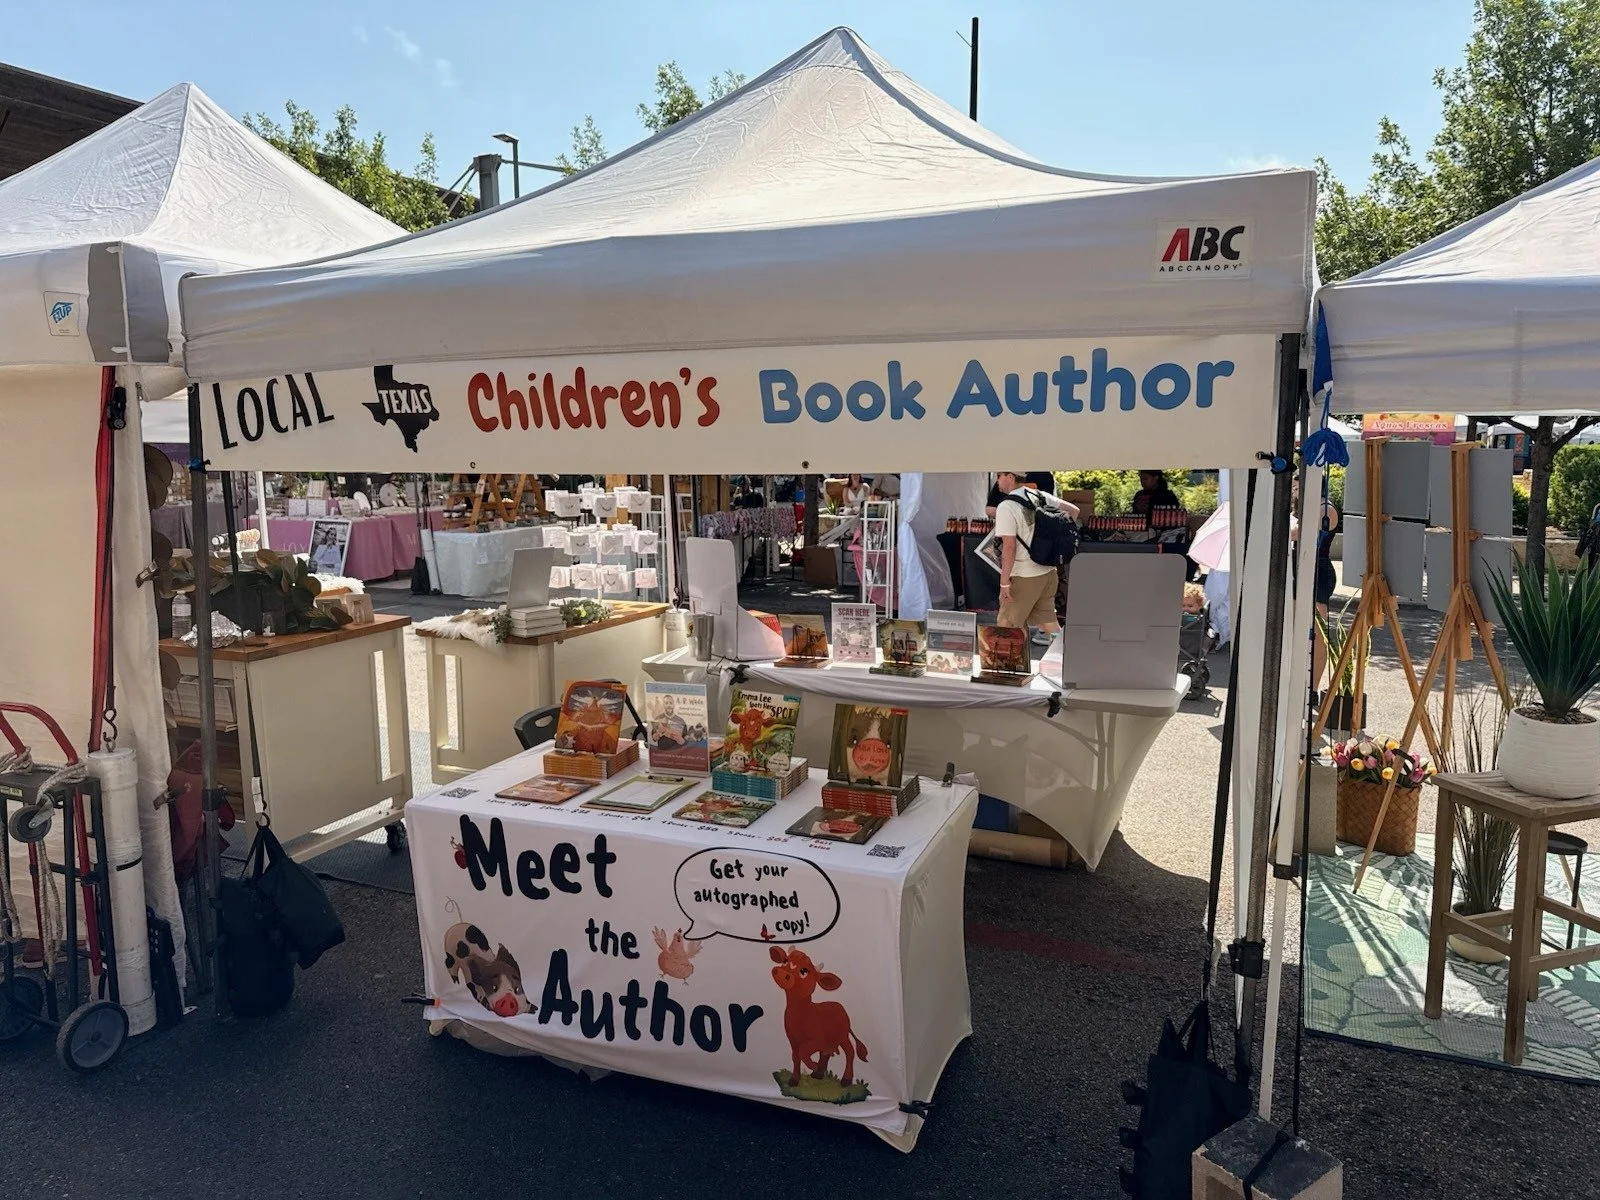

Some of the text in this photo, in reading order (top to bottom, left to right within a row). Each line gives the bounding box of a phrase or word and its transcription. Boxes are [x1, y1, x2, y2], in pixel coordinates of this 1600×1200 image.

[1161, 225, 1245, 261] ABC
[467, 366, 720, 433] Children's
[758, 347, 1235, 423] Book Author
[212, 372, 335, 450] LOCAL
[377, 388, 432, 414] TEXAS
[837, 607, 870, 617] SCAN HERE
[737, 691, 772, 703] Emma Lee
[770, 706, 794, 719] SPOT
[459, 813, 617, 900] Meet
[709, 858, 789, 882] Get your
[693, 886, 800, 913] autographed
[584, 917, 640, 960] the
[775, 910, 811, 936] copy!
[537, 948, 764, 1053] Author
